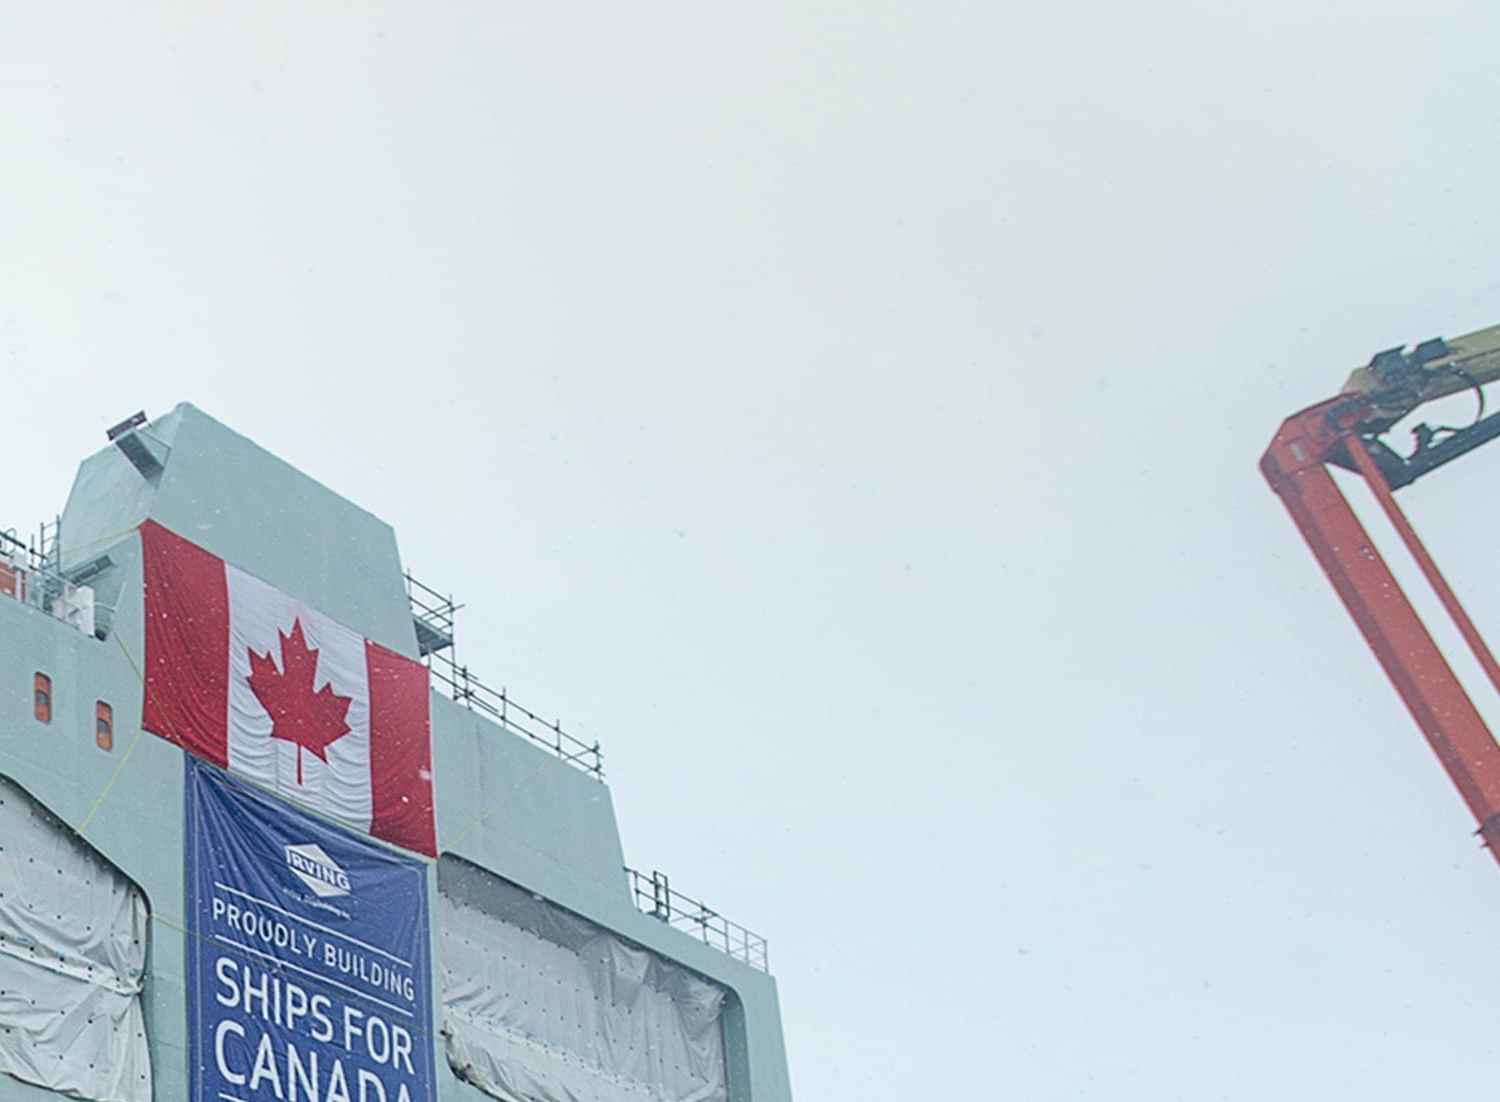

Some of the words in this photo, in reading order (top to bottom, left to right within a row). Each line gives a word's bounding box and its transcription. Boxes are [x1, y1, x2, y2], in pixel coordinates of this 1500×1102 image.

[284, 847, 352, 892] IRVING
[212, 897, 317, 958] PROUDLY
[324, 943, 415, 1001] BUILDING
[215, 956, 334, 1043] SHIPS
[344, 1005, 416, 1076] FOR
